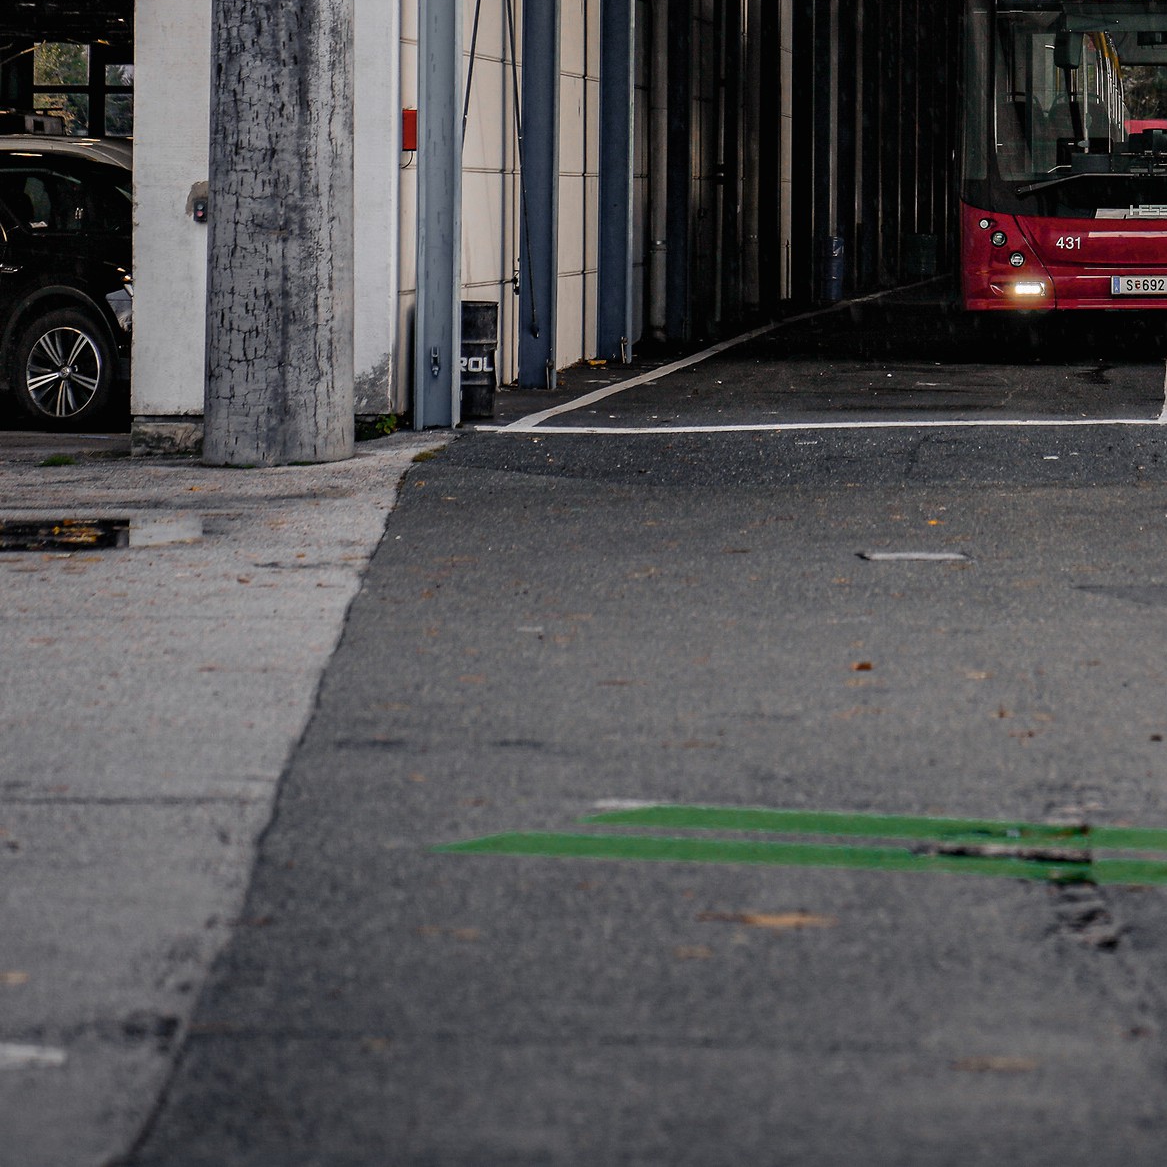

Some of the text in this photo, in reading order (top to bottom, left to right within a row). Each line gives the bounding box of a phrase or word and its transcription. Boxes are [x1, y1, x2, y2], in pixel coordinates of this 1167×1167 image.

[1055, 236, 1081, 249] 431
[1126, 279, 1133, 291] S
[1142, 279, 1165, 291] 692
[460, 357, 494, 373] ROL
